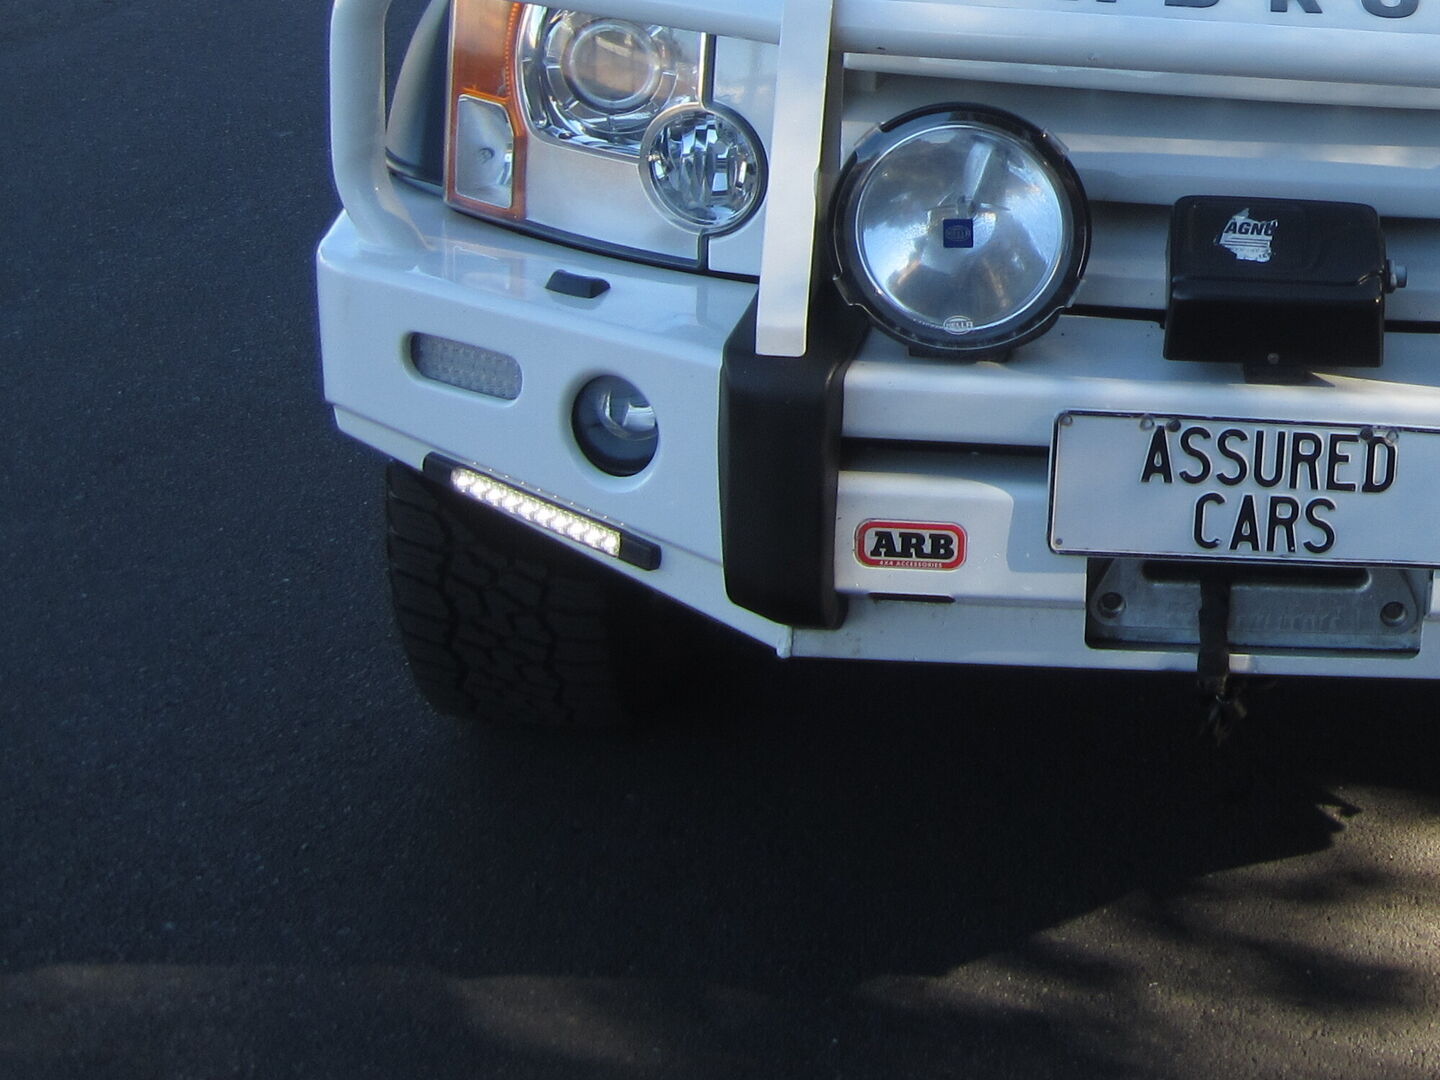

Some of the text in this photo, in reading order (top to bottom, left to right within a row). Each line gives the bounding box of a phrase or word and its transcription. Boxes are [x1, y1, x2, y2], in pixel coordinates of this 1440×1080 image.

[1140, 425, 1398, 494] ASSURED
[870, 530, 955, 560] ARB
[1193, 492, 1336, 554] CARS
